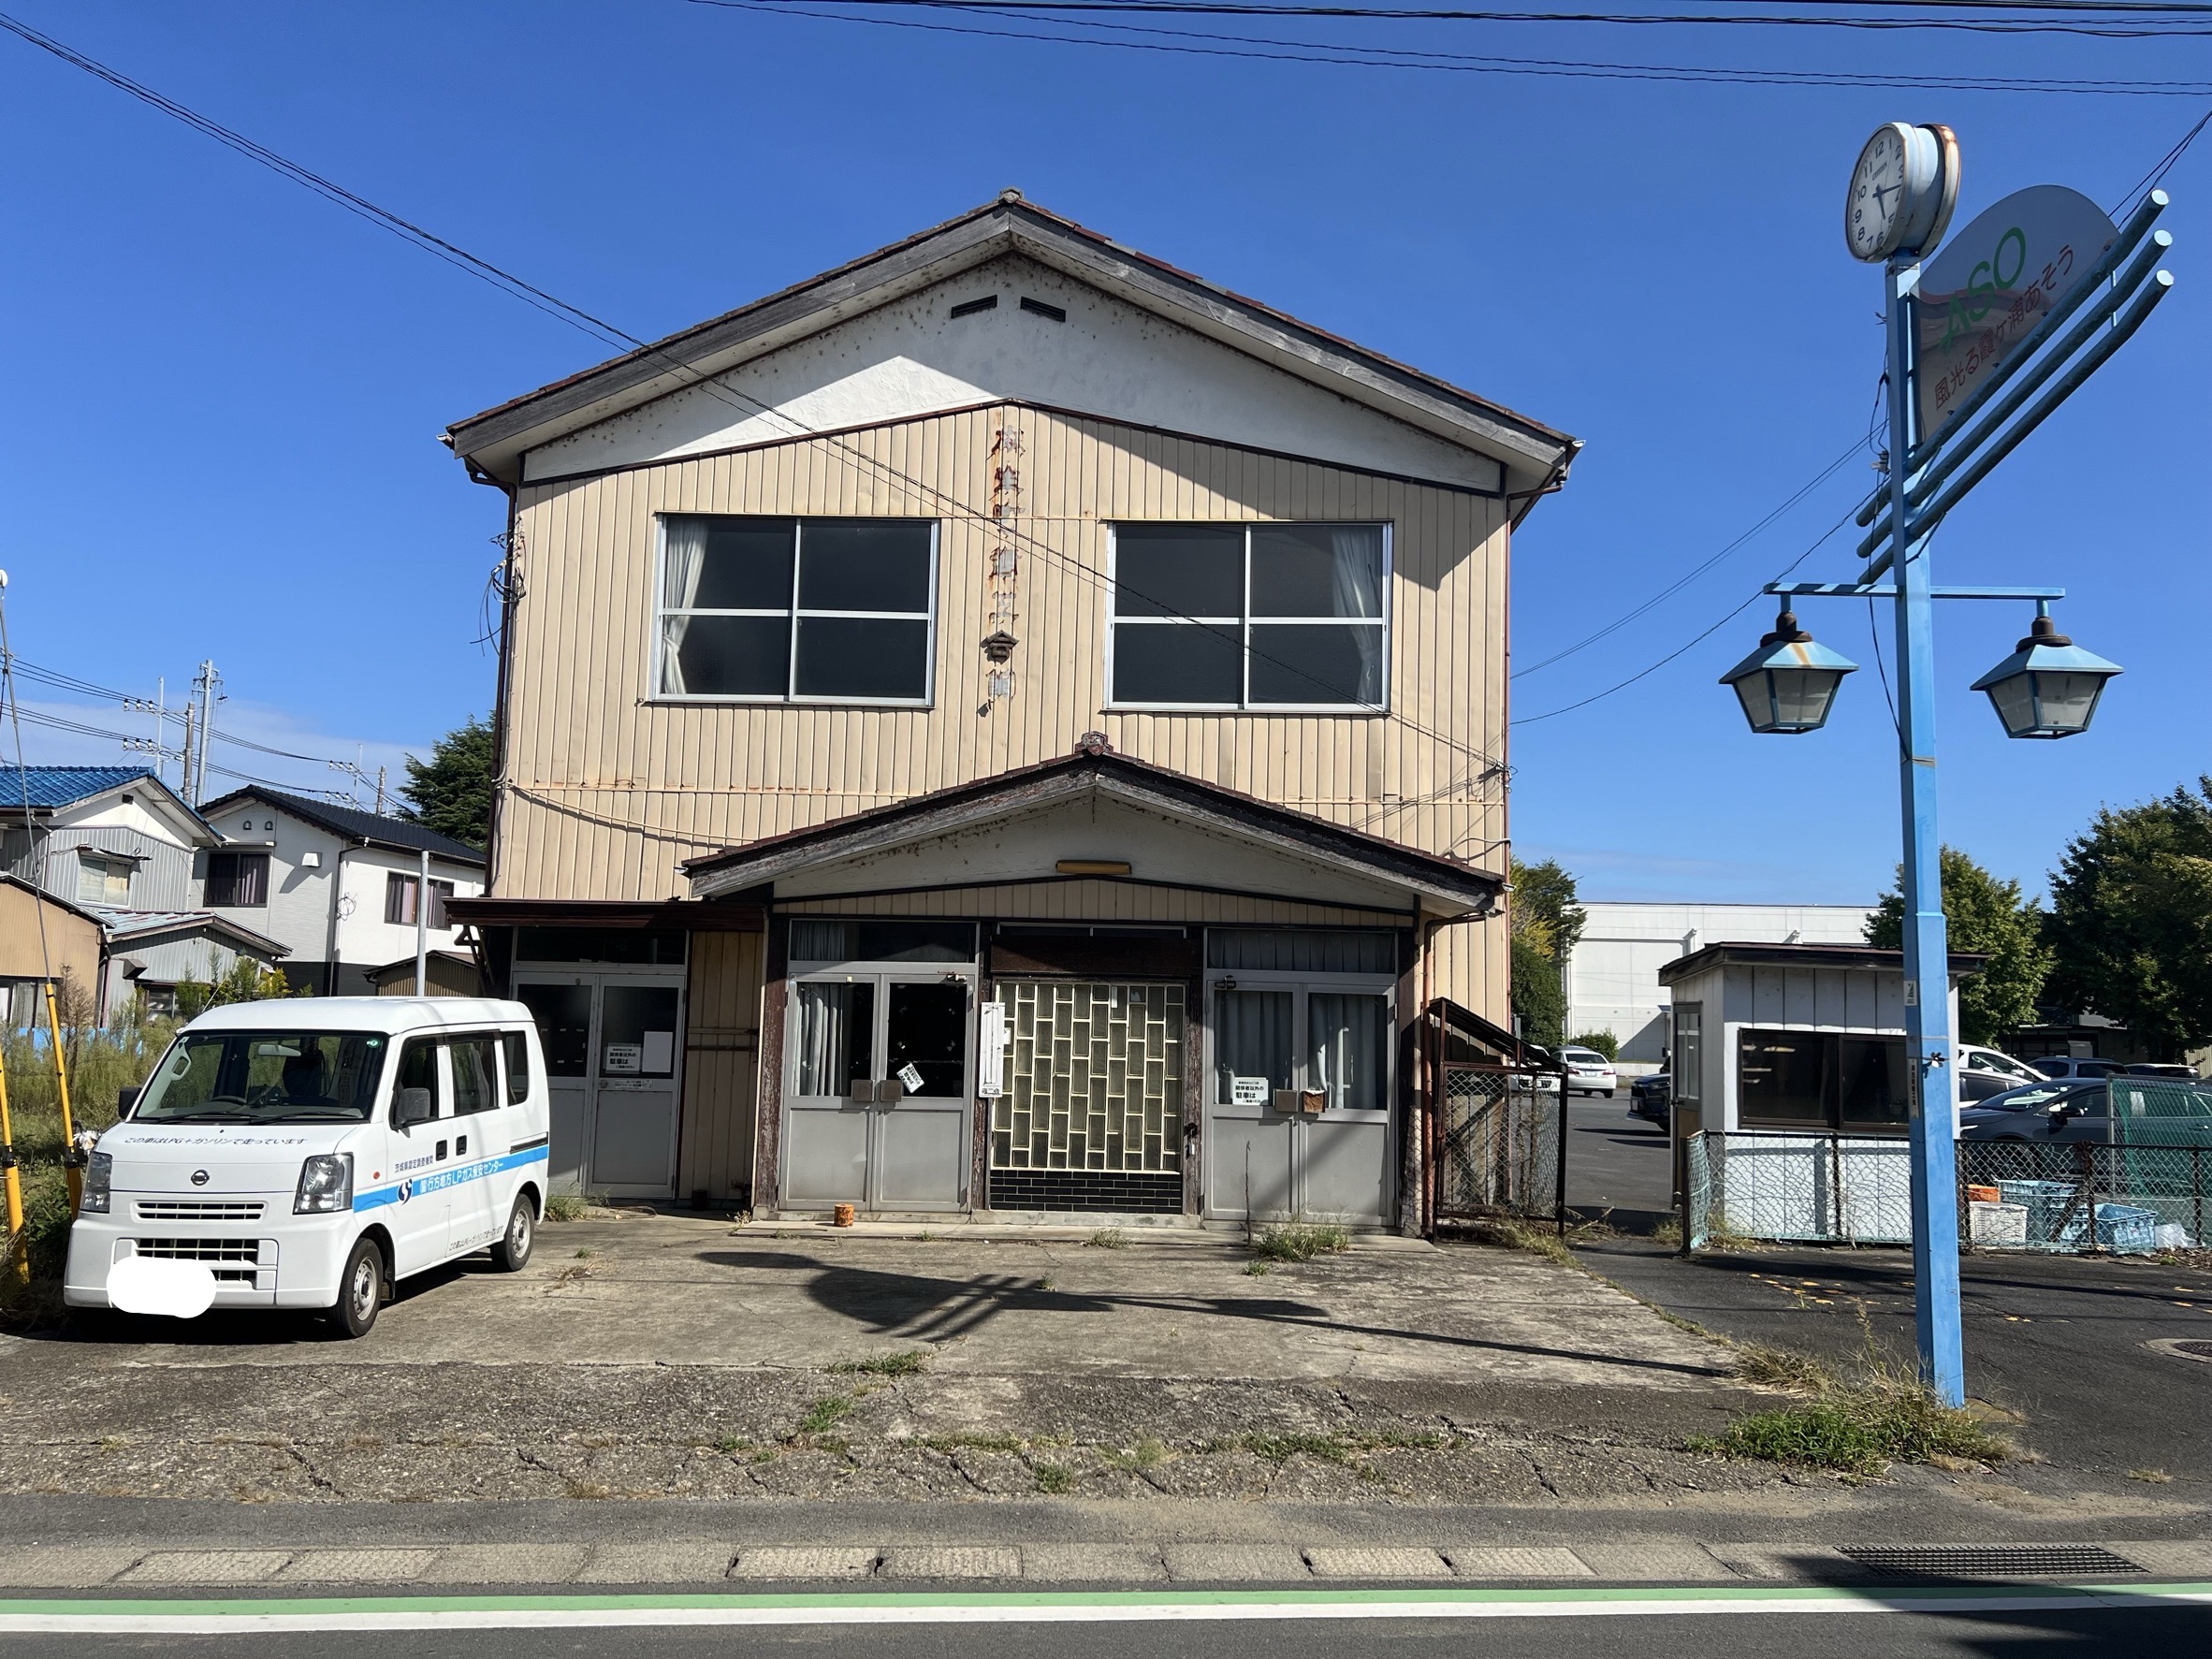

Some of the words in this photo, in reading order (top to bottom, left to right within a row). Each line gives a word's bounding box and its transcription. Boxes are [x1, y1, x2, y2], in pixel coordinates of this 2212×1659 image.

[1875, 141, 1885, 159] 12
[1895, 145, 1902, 160] 2
[1864, 161, 1872, 178] 11
[1857, 185, 1867, 202] 10
[1855, 209, 1862, 224] 9
[1857, 226, 1865, 241] 8
[1876, 231, 1884, 246] 6
[1866, 235, 1873, 250] 7
[1937, 226, 2027, 356] ASO
